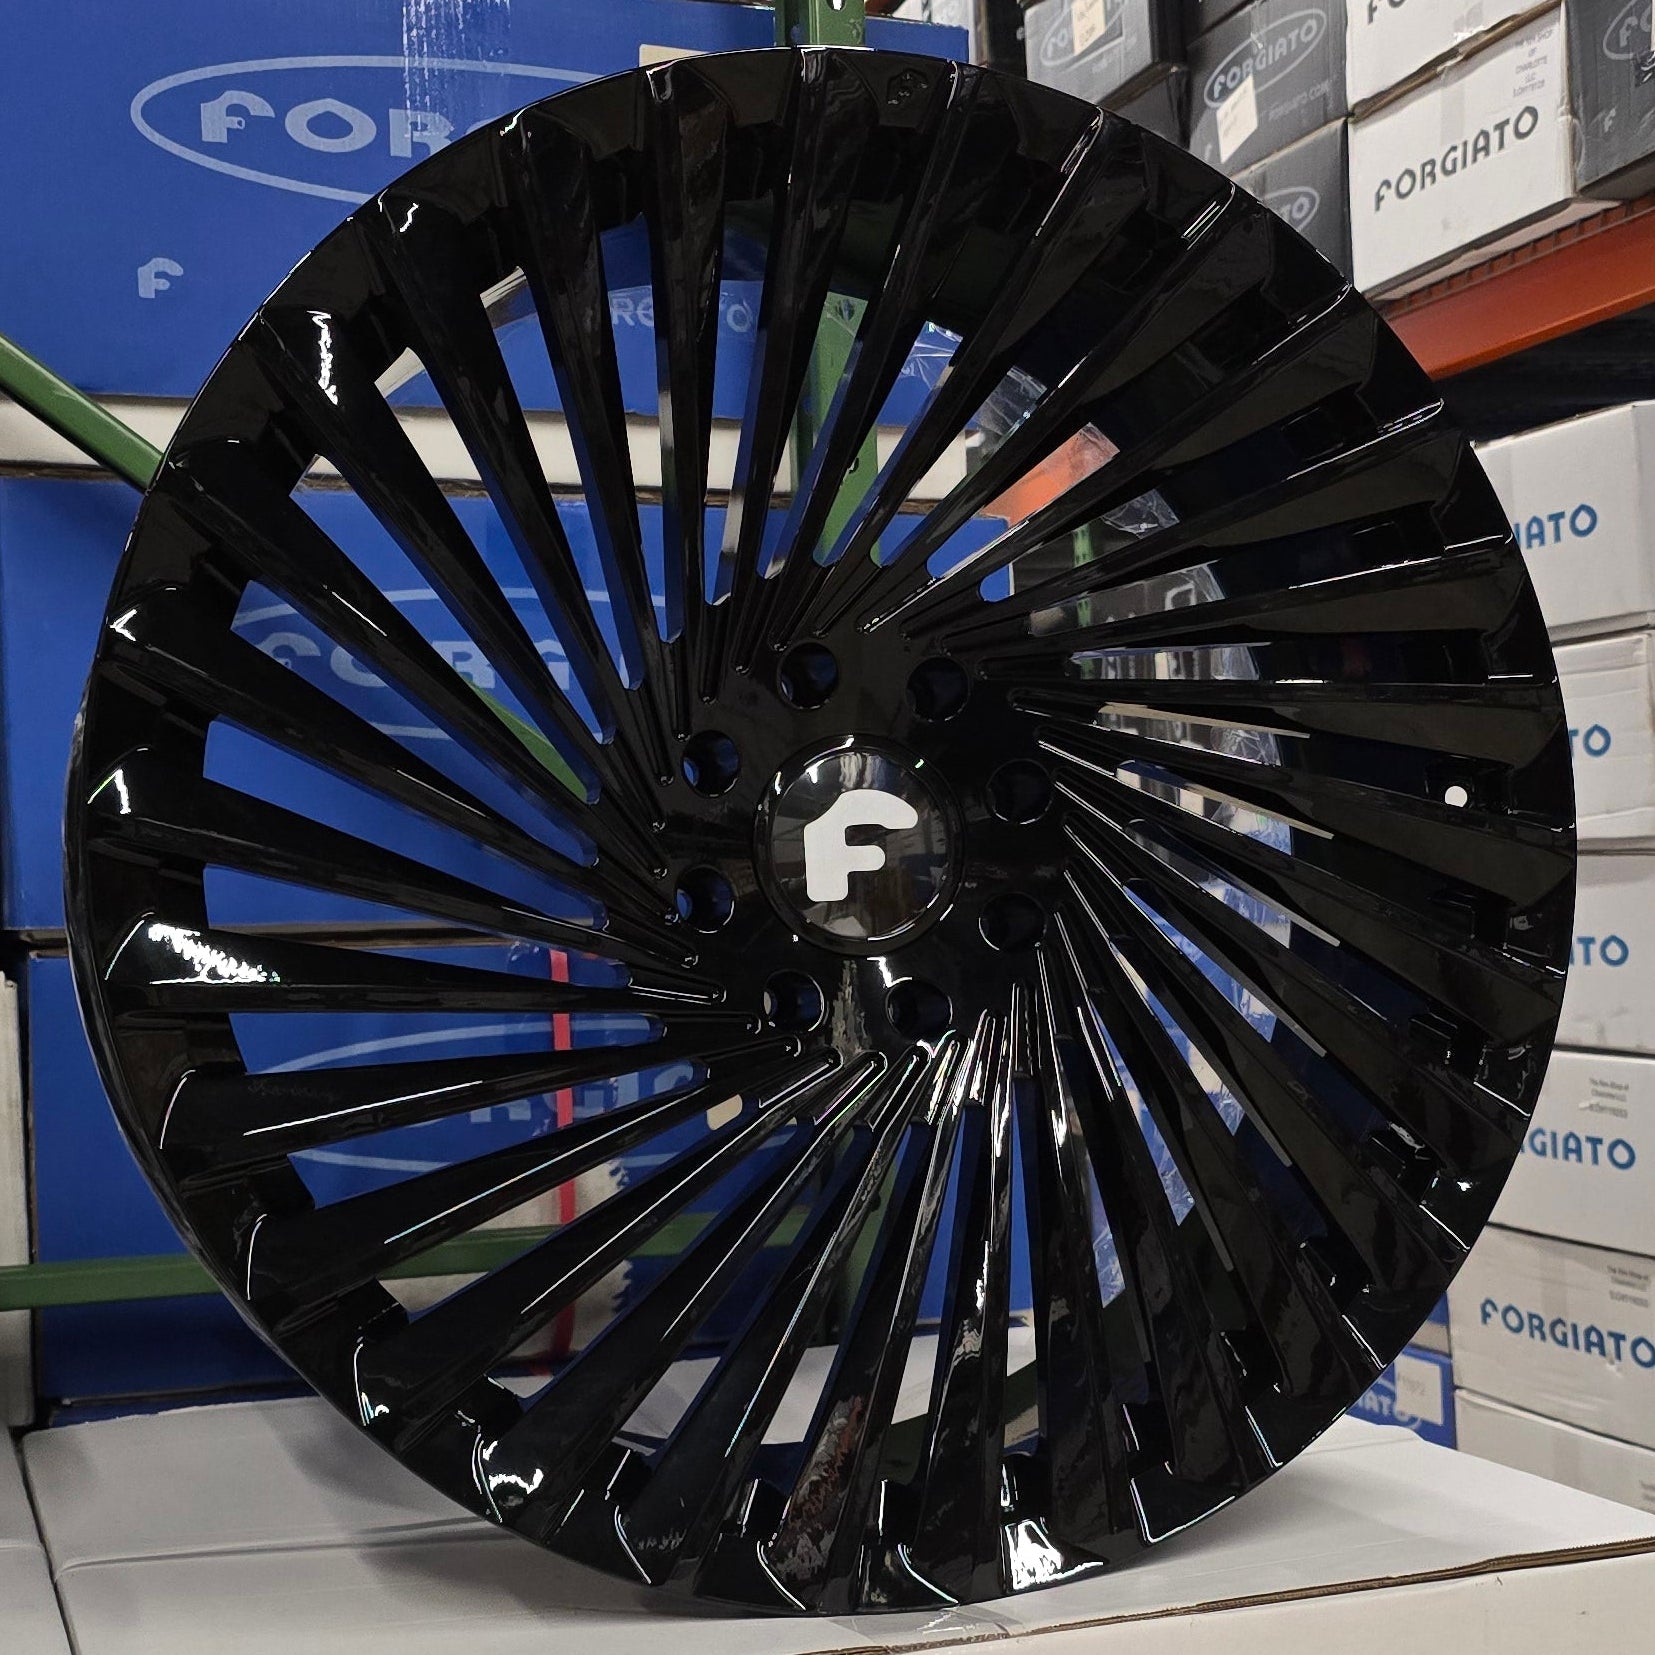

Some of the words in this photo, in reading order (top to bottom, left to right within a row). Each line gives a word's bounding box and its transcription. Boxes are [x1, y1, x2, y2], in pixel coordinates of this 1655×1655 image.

[1213, 18, 1317, 99] FORGIATO
[1374, 105, 1539, 212] FORGIATO
[137, 257, 184, 299] F
[803, 788, 919, 902] F
[1520, 1127, 1637, 1170] GIATO
[1480, 1297, 1655, 1369] FORGIATO
